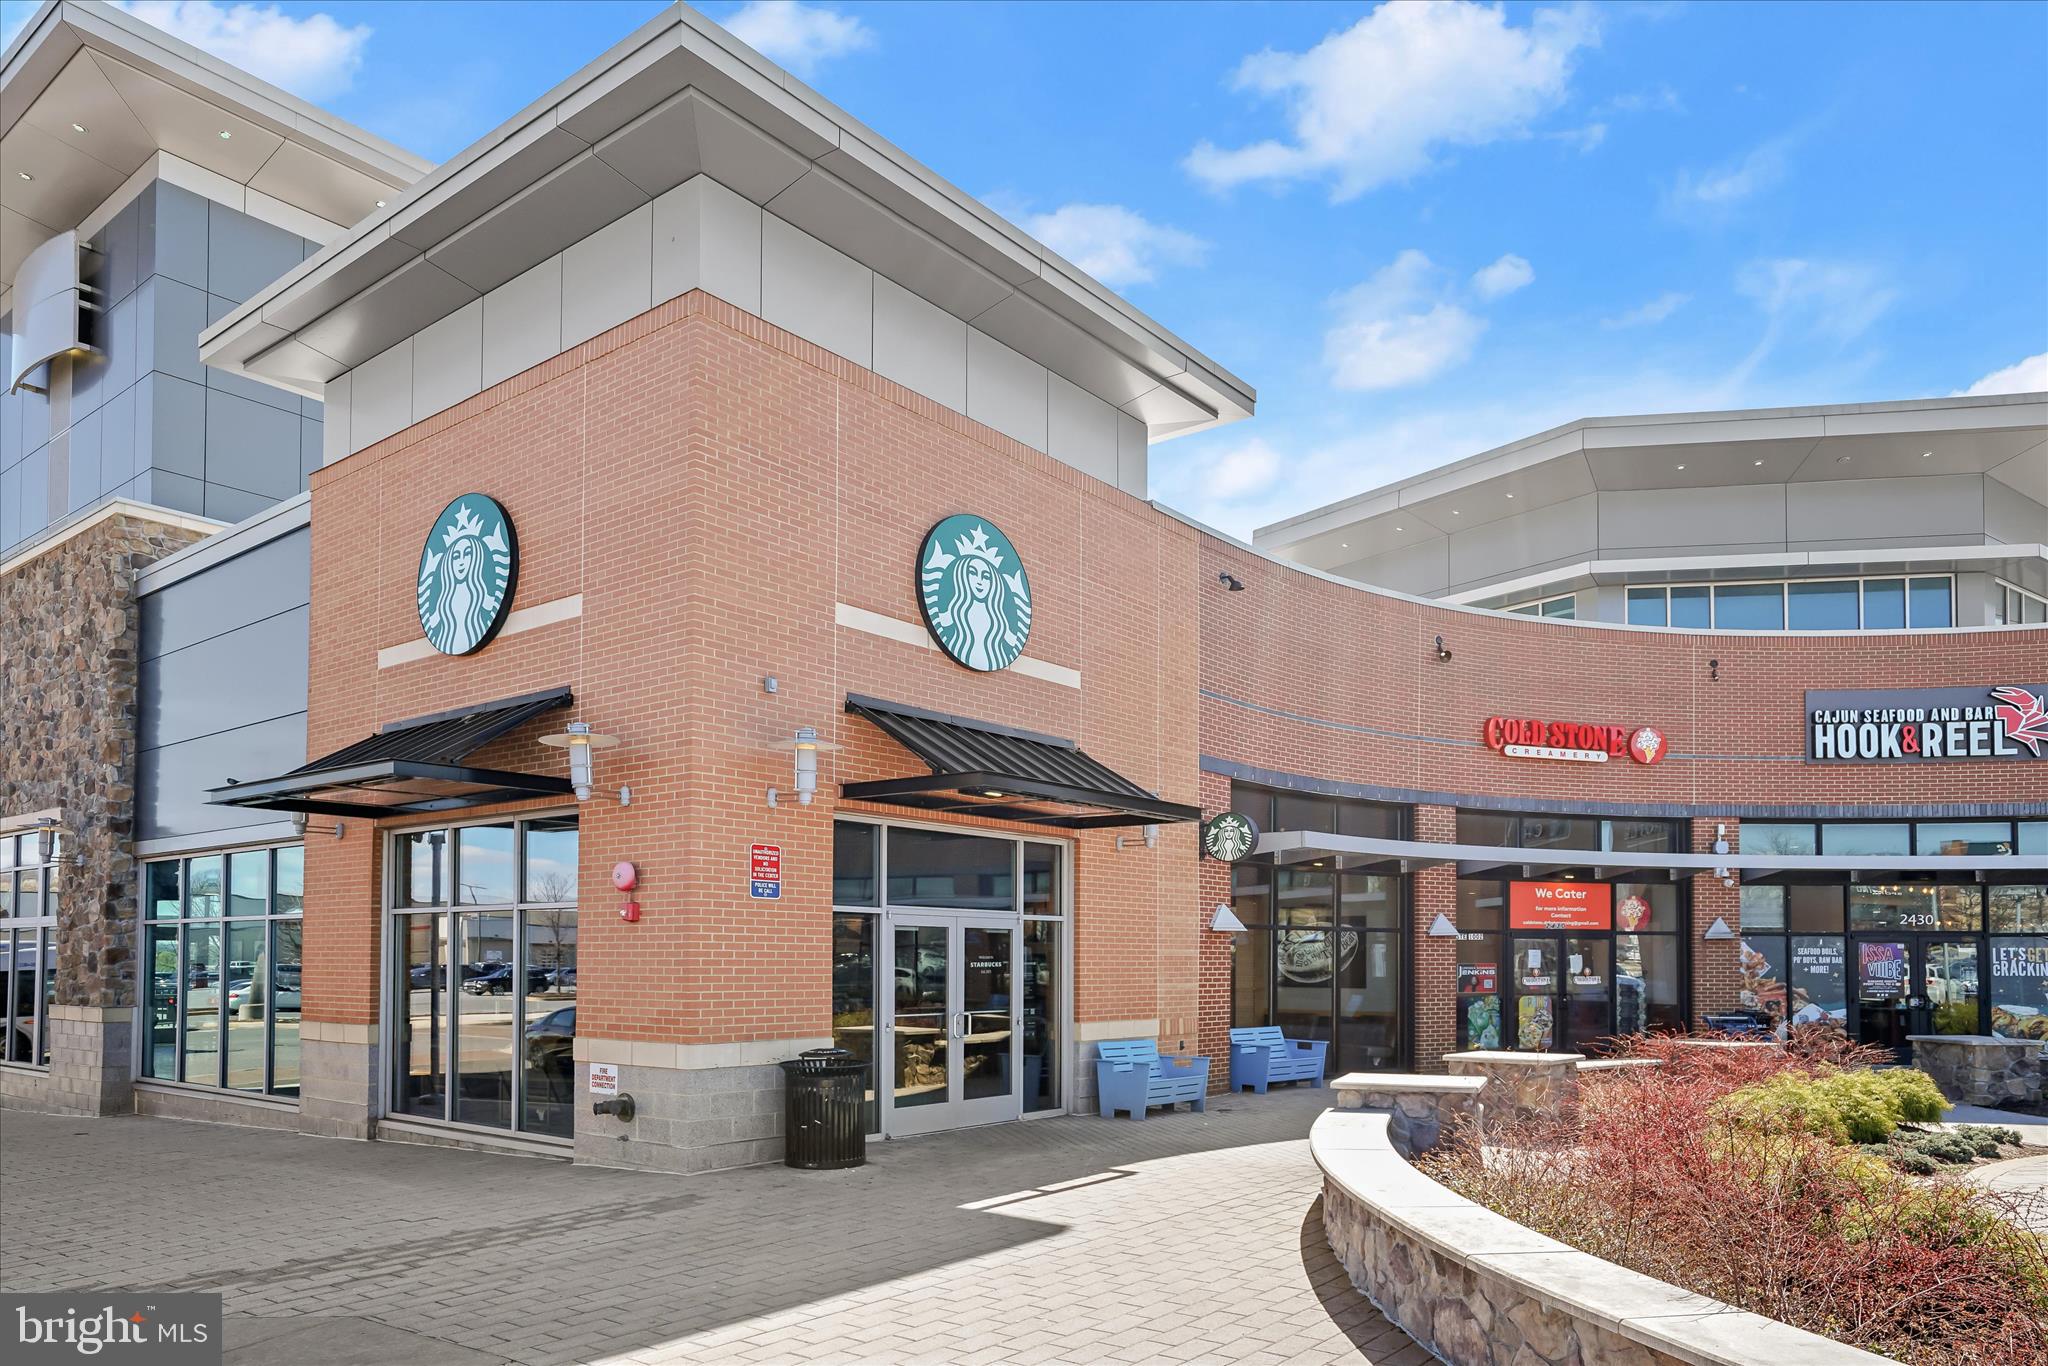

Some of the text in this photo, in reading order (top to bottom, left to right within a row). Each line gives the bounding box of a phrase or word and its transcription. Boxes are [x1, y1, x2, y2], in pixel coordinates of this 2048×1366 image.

[1814, 706, 1994, 723] CAJUN SEAFOOD AND BAR
[1485, 716, 1626, 757] COLD STONE
[1511, 747, 1602, 760] CREAMERY
[1535, 887, 1587, 899] We Cater
[1900, 913, 1934, 927] 2430
[1797, 947, 1838, 956] SEAFOOD BOILS,
[1862, 943, 1894, 965] ISSA
[1992, 947, 2027, 964] LET'S
[1818, 956, 1831, 964] RAW
[1831, 956, 1843, 964] BAR
[1810, 965, 1829, 974] MORE!
[592, 1074, 616, 1082] DEPARTMENT
[592, 1081, 616, 1089] CONNECTION
